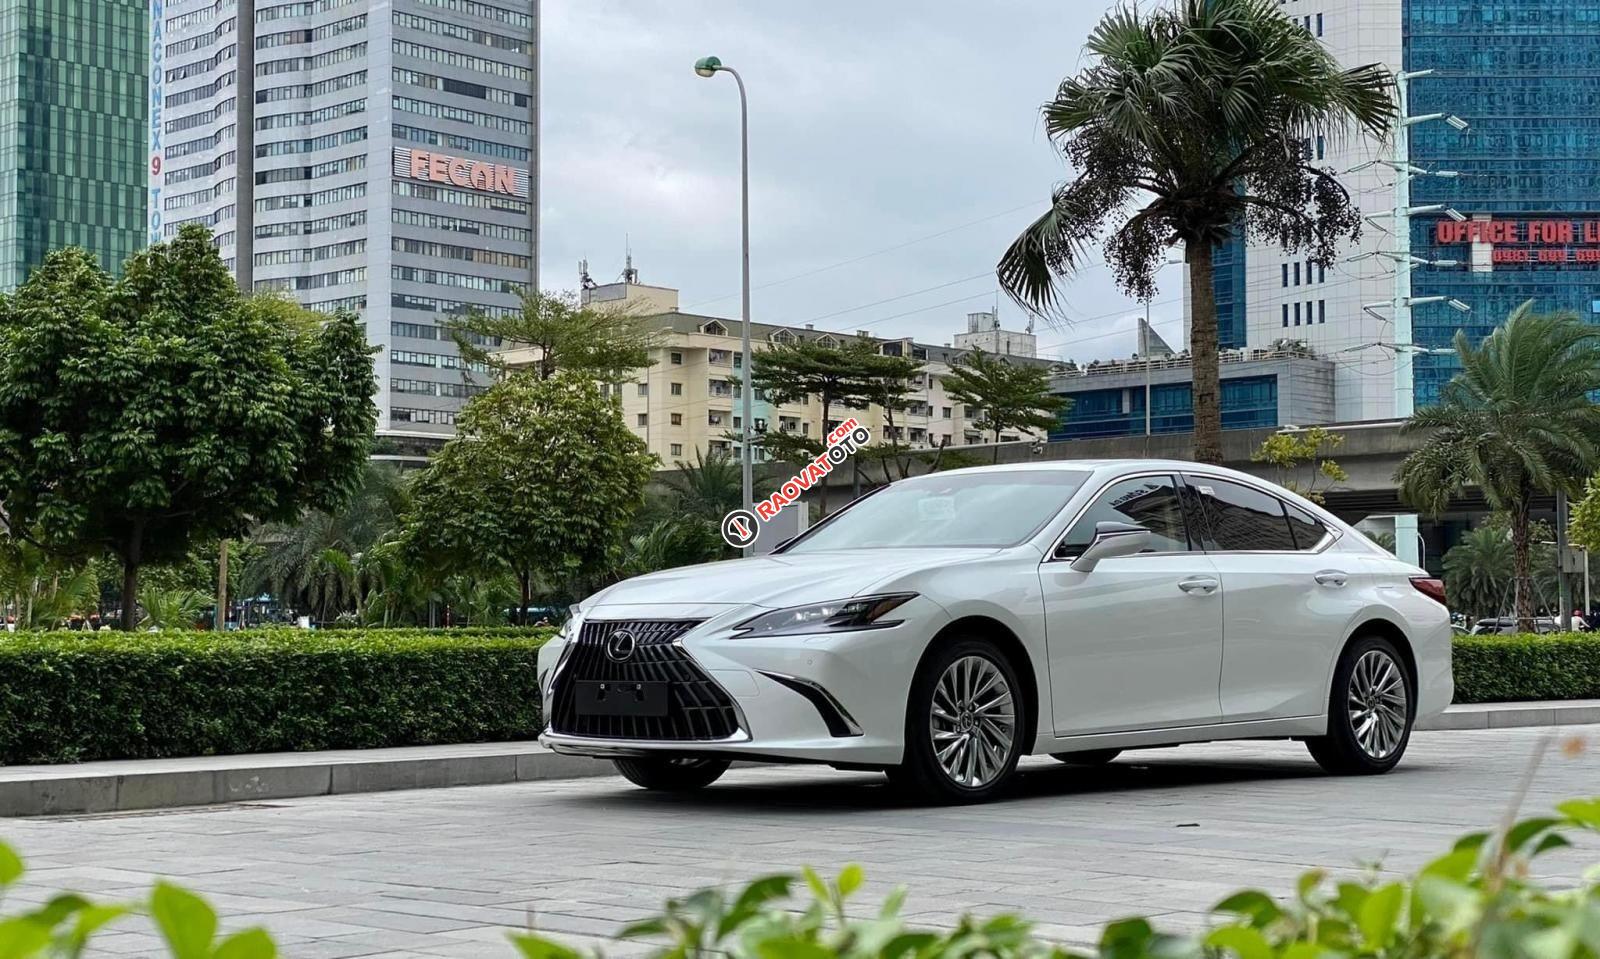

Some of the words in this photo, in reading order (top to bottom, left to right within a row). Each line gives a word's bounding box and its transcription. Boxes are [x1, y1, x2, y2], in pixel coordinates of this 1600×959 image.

[152, 0, 162, 151] NACONEX
[152, 156, 161, 176] 9
[1437, 221, 1518, 243] OFFICE
[1528, 221, 1573, 243] FOR
